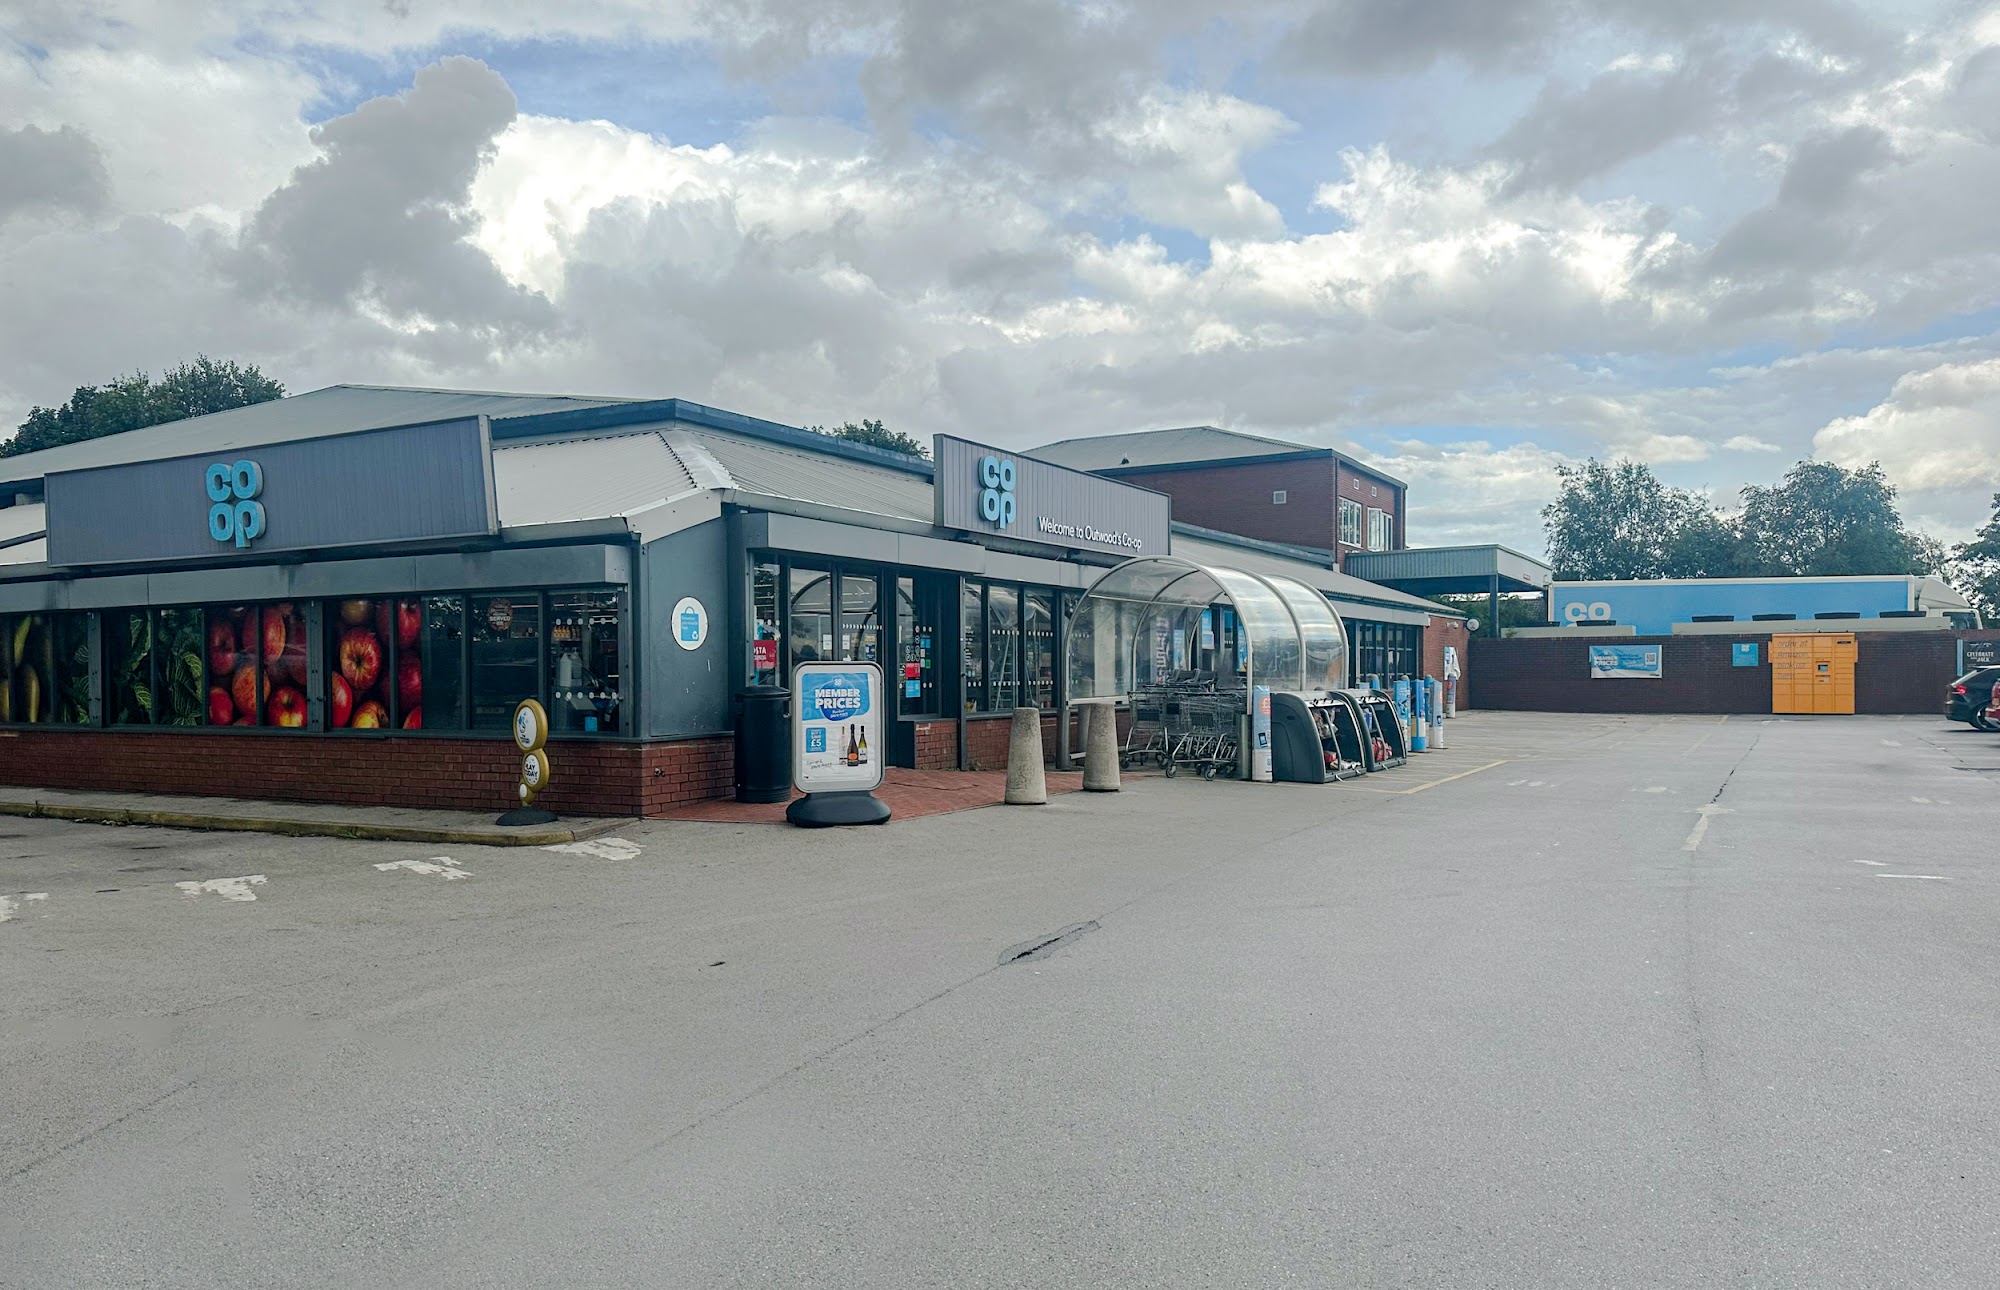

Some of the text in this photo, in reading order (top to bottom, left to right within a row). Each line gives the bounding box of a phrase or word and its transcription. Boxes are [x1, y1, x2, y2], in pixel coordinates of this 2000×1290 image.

[1039, 516, 1142, 552] Welcome to Outwood's Co-op
[815, 689, 860, 697] MEMBER
[815, 698, 861, 709] PRICES
[810, 739, 822, 747] £5
